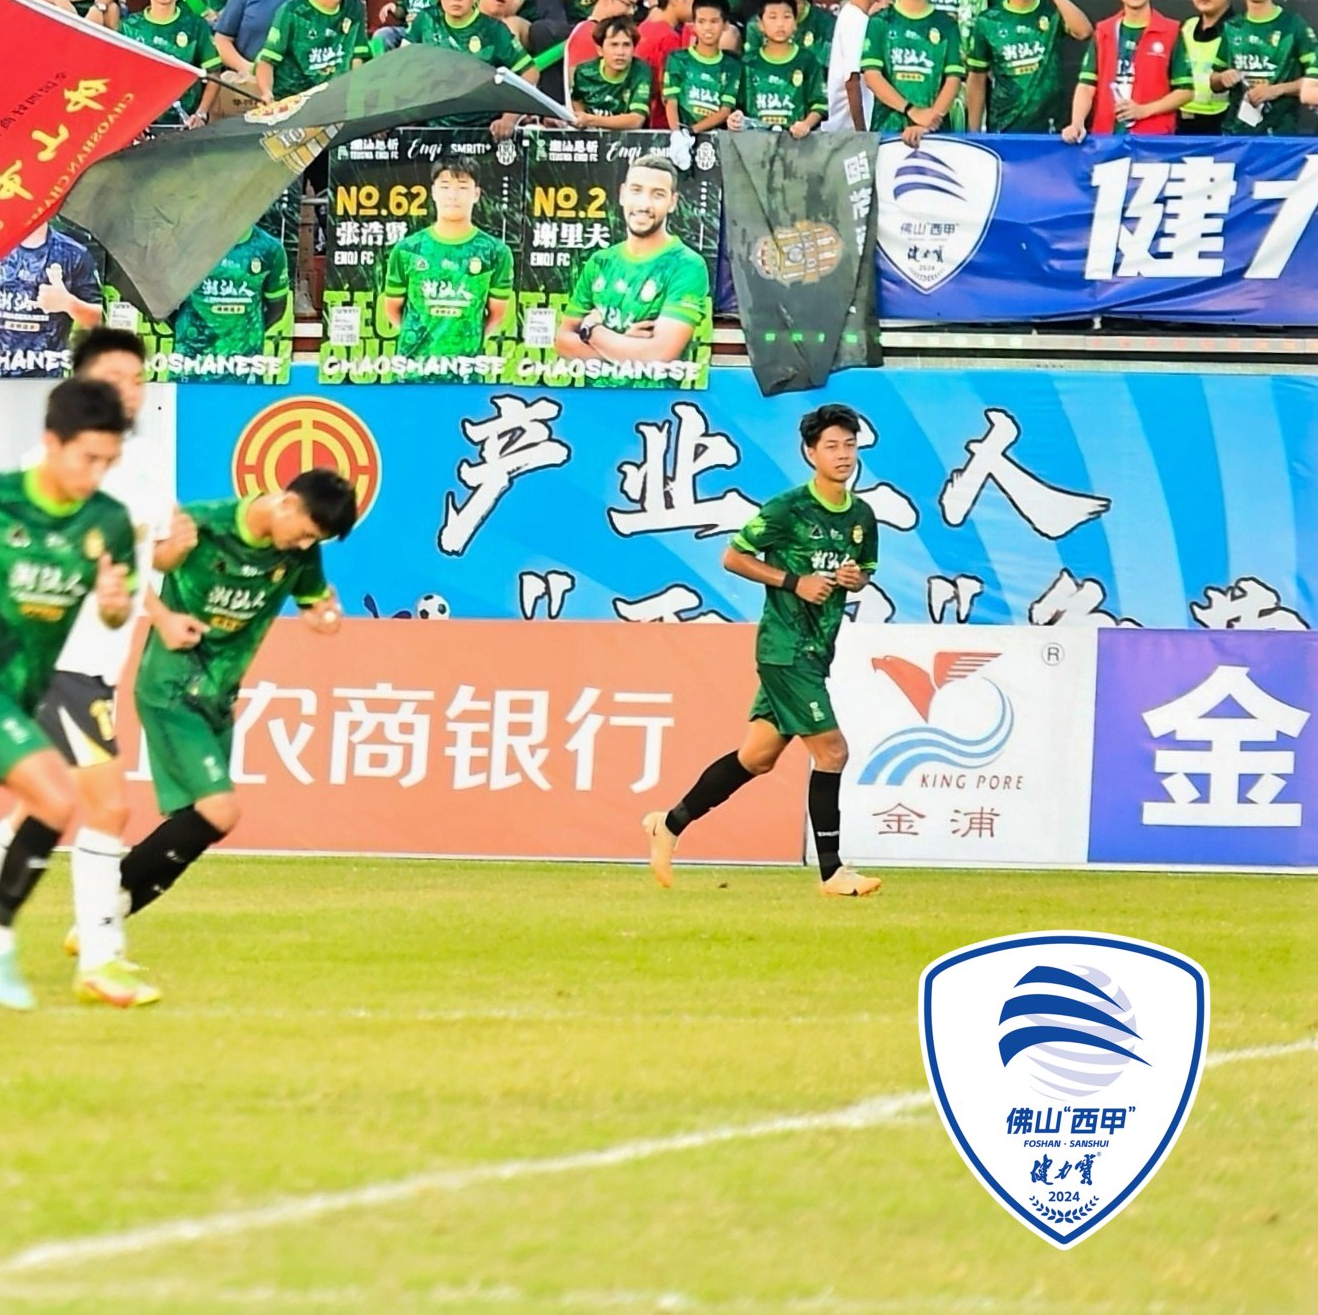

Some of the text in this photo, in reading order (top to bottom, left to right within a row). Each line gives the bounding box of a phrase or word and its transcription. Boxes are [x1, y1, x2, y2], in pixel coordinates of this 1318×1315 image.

[532, 222, 610, 249] 谢里夫
[1141, 664, 1311, 828] 金
[921, 774, 1023, 791] KING PORE
